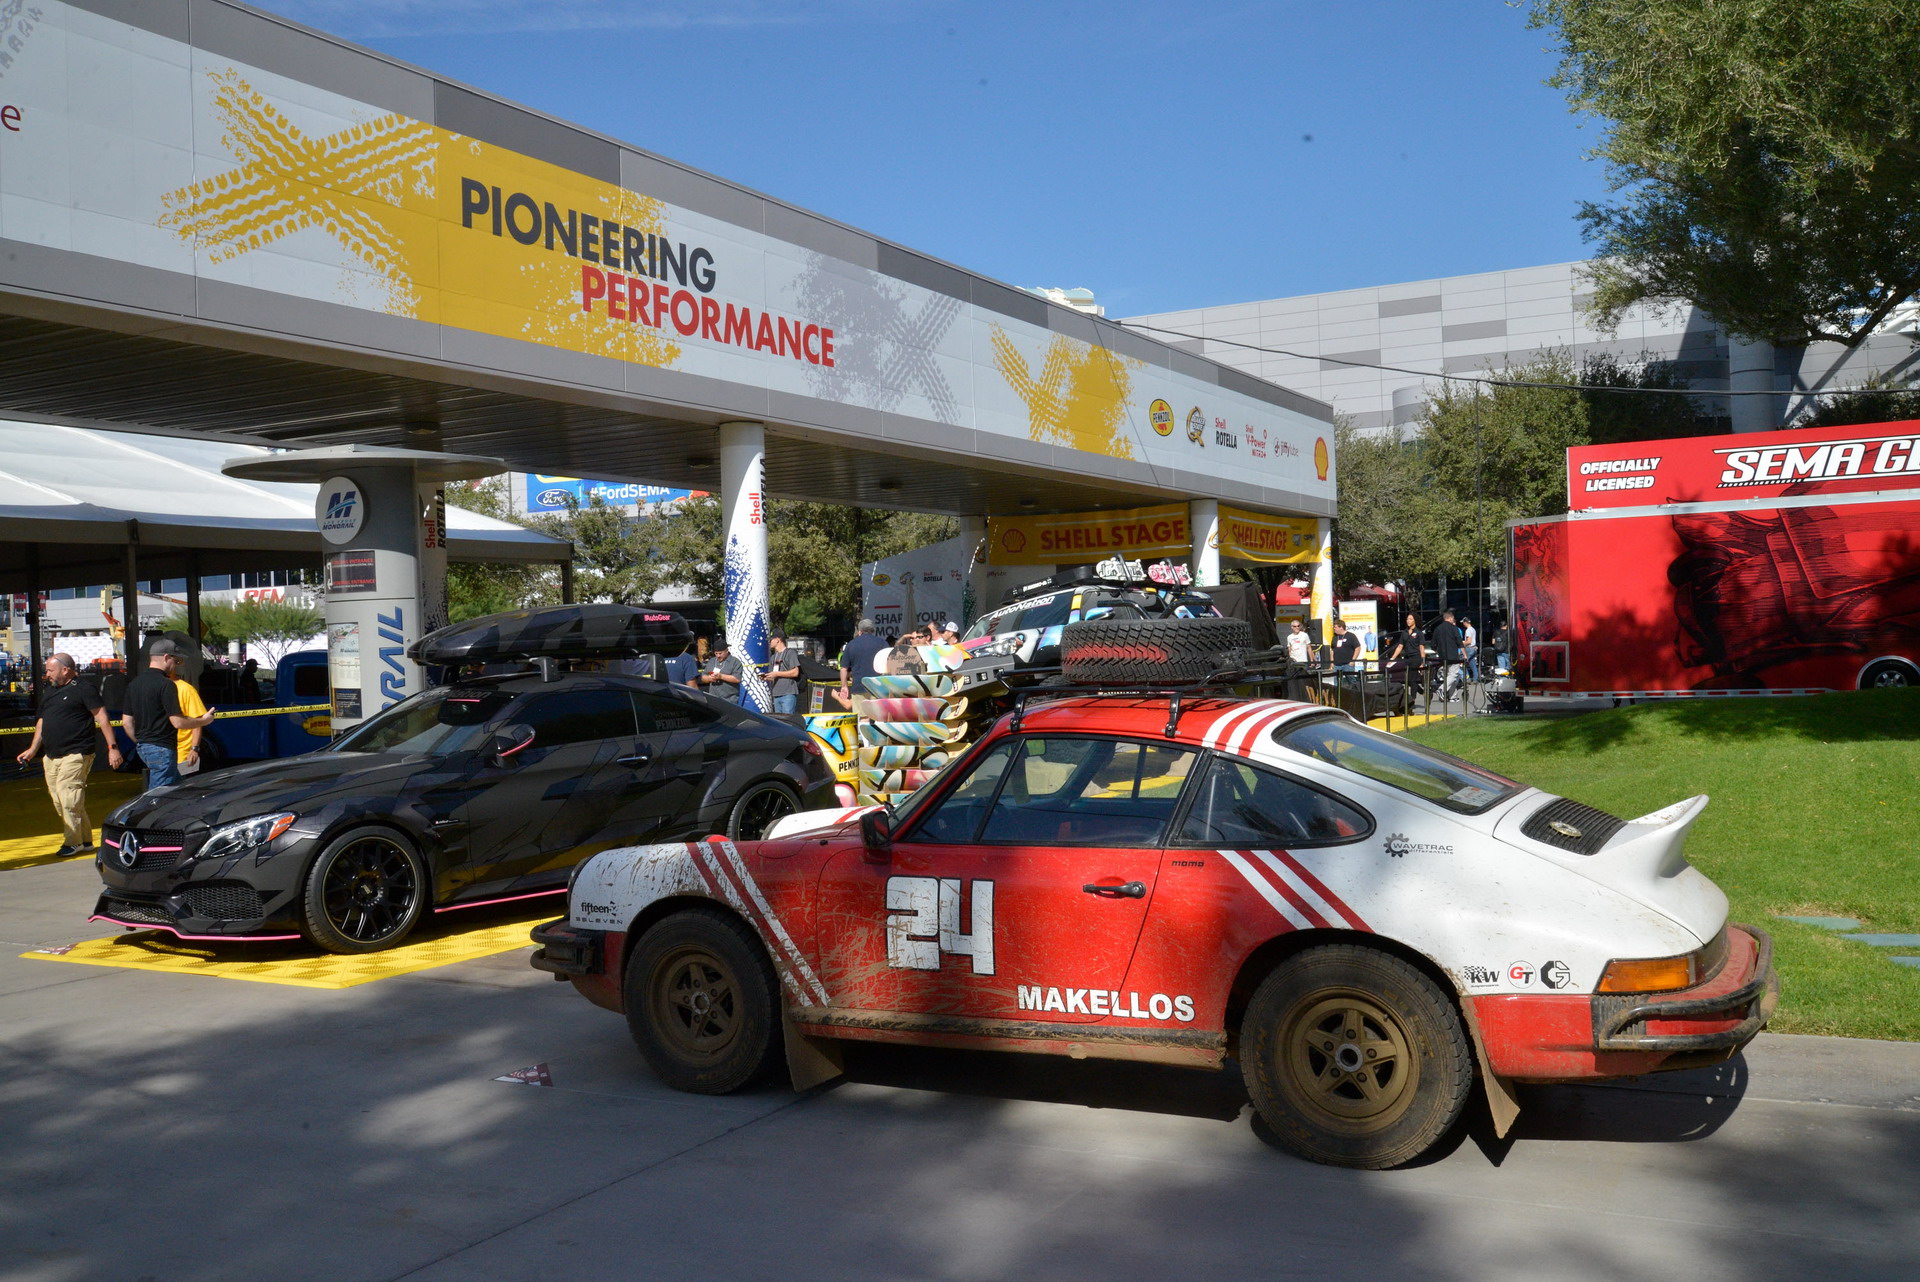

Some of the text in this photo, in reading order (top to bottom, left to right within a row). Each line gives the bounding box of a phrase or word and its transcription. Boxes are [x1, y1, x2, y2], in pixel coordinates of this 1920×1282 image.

[461, 176, 716, 293] PIONEERING
[582, 265, 835, 367] PERFORMANCE
[1215, 417, 1226, 430] Shell
[1216, 430, 1238, 450] ROTELLA
[1580, 457, 1662, 476] OFFICIALLY
[1720, 444, 1867, 484] SEMA
[1585, 475, 1655, 492] LICENSED
[436, 488, 446, 549] ROTELLA
[749, 492, 761, 525] Shell
[424, 519, 436, 549] Shell
[1041, 519, 1185, 551] SHELL STAGE
[989, 596, 1056, 620] AutoNation
[1393, 842, 1454, 851] WAVETRAC
[1171, 860, 1205, 868] momo
[885, 876, 996, 976] 24
[1470, 970, 1500, 984] KW
[1017, 985, 1196, 1022] MAKELLOS
